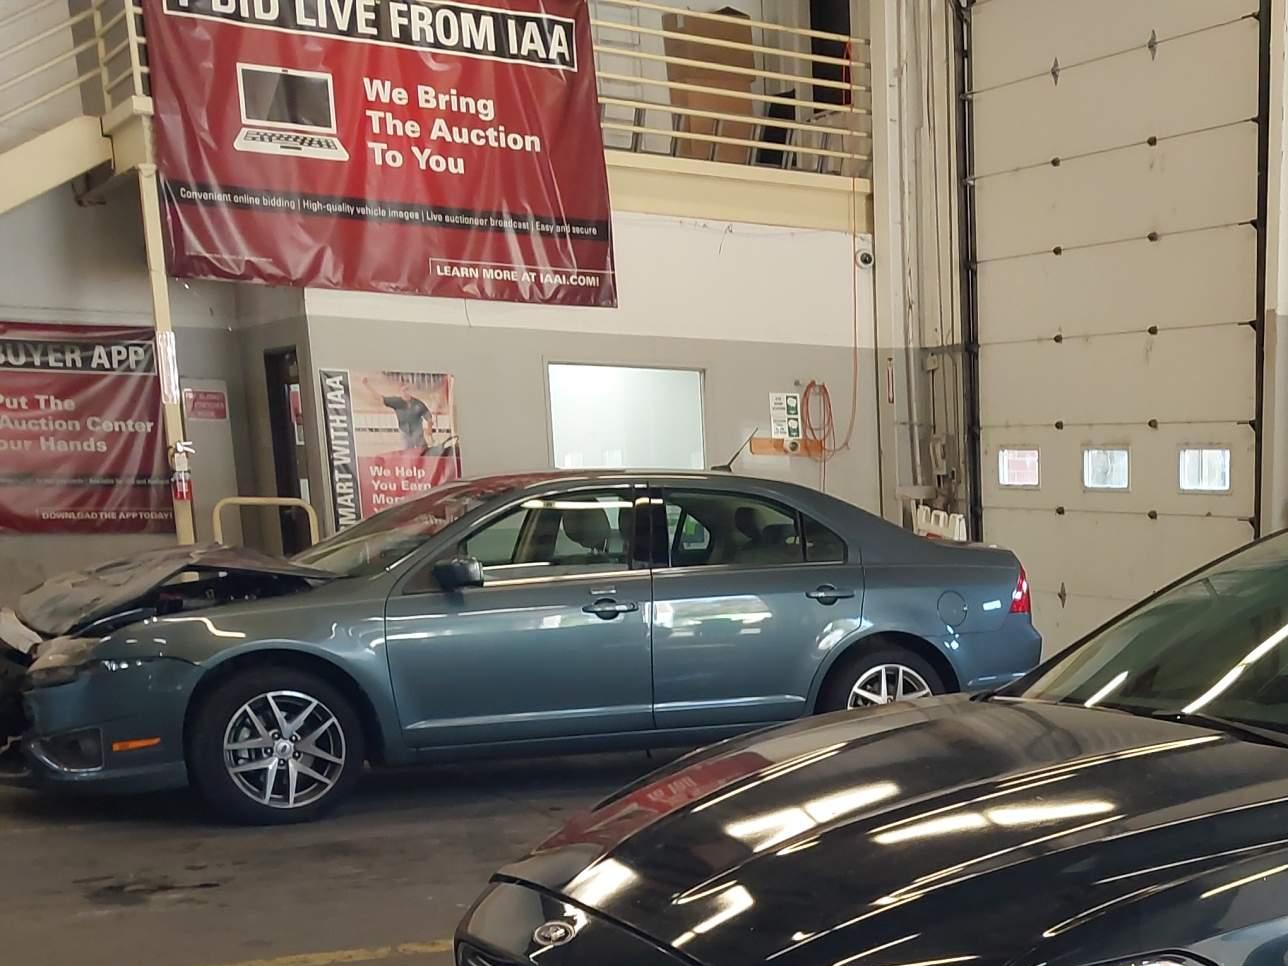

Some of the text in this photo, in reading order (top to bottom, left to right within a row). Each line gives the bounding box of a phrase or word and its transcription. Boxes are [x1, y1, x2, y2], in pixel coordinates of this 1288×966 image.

[296, 0, 378, 35] LIVE
[389, 2, 496, 51] FROM
[507, 19, 571, 61] IAA
[363, 77, 495, 121] We Bring
[366, 109, 541, 152] The Auction
[367, 142, 464, 174] To You
[180, 187, 232, 202] Convenient
[233, 194, 260, 205] online
[262, 196, 296, 210] bidding
[302, 199, 355, 215] High-quality
[356, 204, 386, 217] vehicle
[388, 208, 419, 220] images
[426, 210, 443, 222] Live
[445, 214, 487, 226] auctioneer
[490, 217, 529, 230] broadcast
[535, 221, 554, 234] Easy
[555, 223, 571, 233] and
[572, 226, 597, 236] secure
[436, 265, 479, 278] LEARN
[482, 268, 518, 281] MORE
[521, 271, 537, 282] AT
[91, 345, 145, 369] APP
[326, 375, 346, 409] IAA
[34, 395, 76, 411] The
[0, 415, 154, 433] Auction Center
[40, 436, 107, 452] Hands
[329, 411, 350, 467] WITH
[369, 466, 425, 479] We Help
[372, 480, 432, 491] You Earn
[372, 494, 404, 504] Mor
[42, 511, 97, 520] DOWNLOAD
[99, 511, 117, 520] THE
[118, 512, 138, 520] APP
